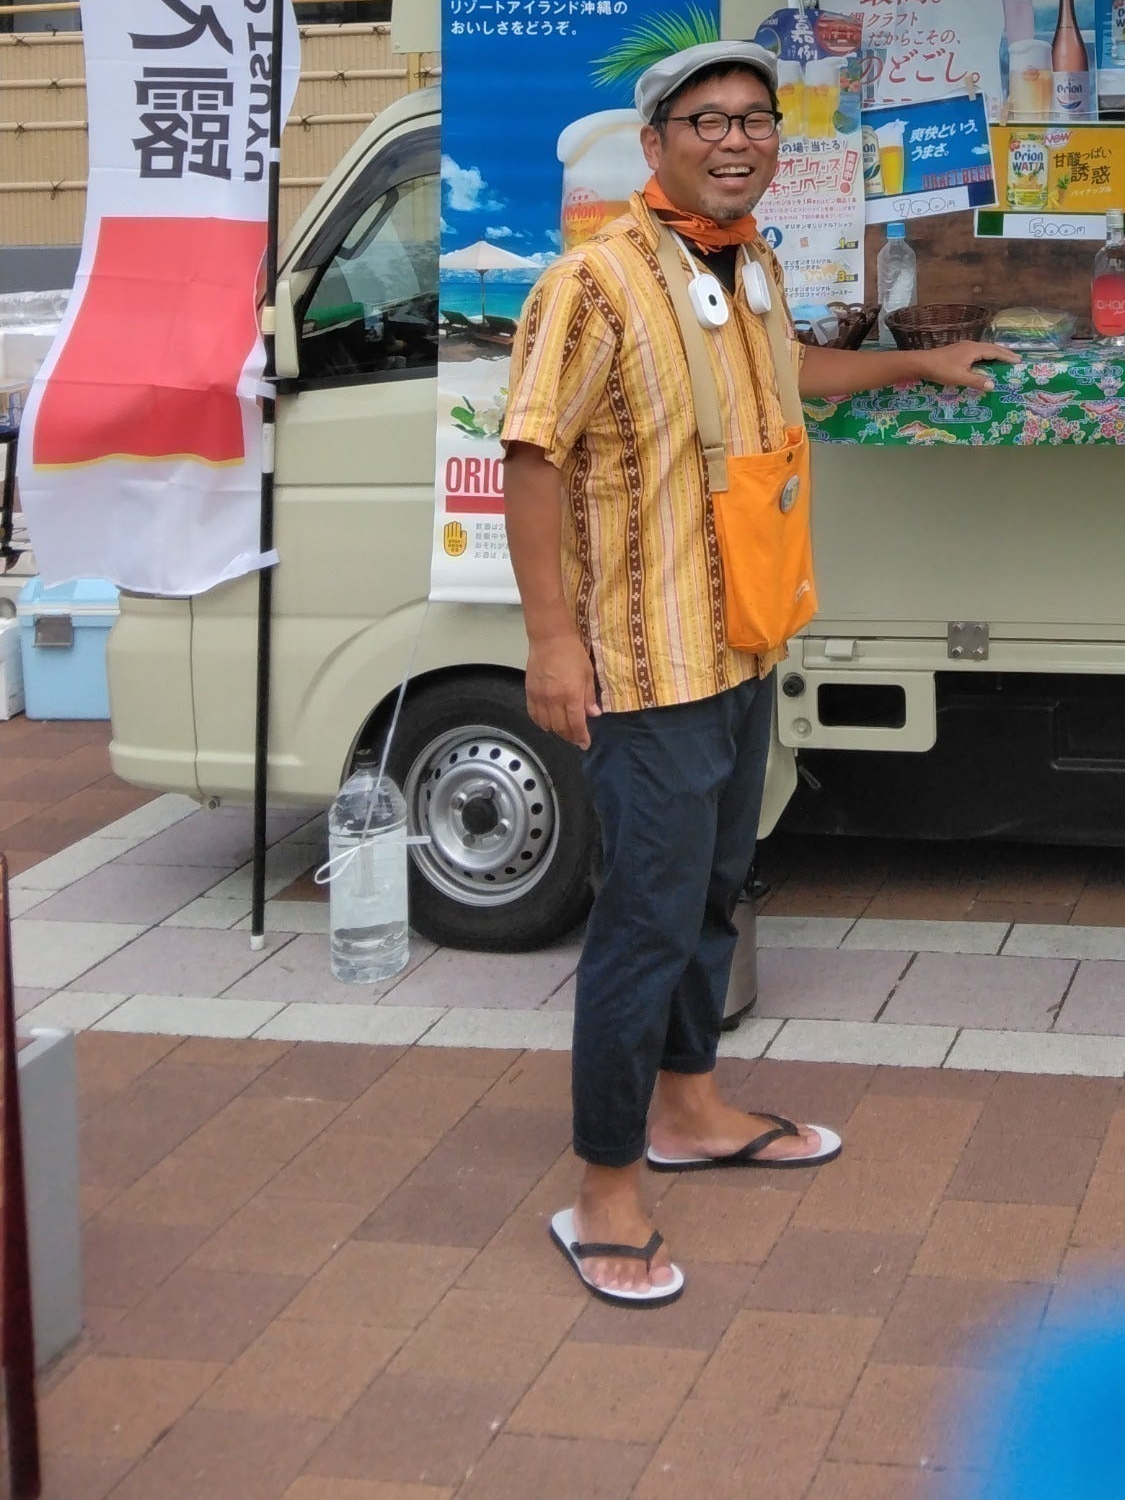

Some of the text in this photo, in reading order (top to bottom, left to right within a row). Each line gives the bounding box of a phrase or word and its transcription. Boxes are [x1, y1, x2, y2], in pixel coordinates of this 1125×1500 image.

[449, 0, 629, 16] リゾートアイランド沖縄の
[450, 21, 577, 36] おいしさをどうぞ。
[868, 29, 962, 48] だからこその、
[860, 48, 981, 84] のどごし。
[909, 119, 978, 143] 爽快という、
[911, 142, 950, 161] うまさ。
[1014, 149, 1044, 162] Orion
[1053, 146, 1113, 168] 甘酸っぱい
[1012, 161, 1045, 172] WATTA
[1070, 162, 1111, 185] 誘惑
[922, 164, 993, 190] DRAFT BEER
[893, 197, 956, 219] 700円
[1028, 217, 1086, 237] 500円
